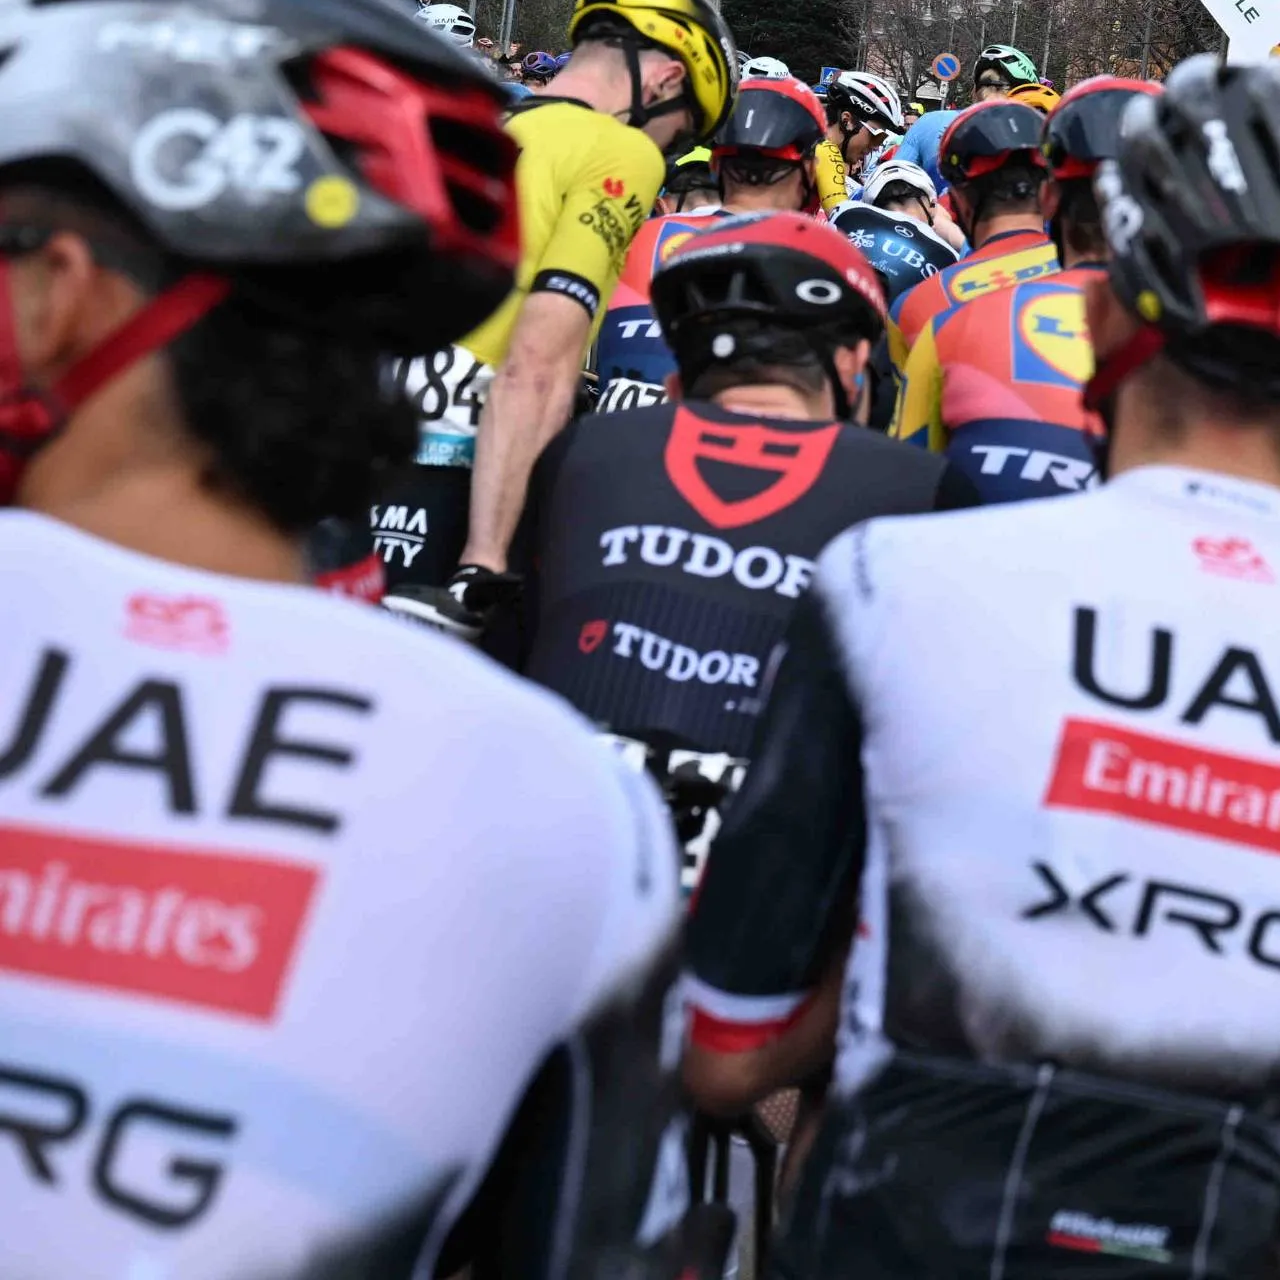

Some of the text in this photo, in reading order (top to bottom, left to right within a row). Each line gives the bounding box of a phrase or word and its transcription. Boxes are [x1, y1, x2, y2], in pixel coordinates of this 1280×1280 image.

[823, 144, 845, 185] Cofid
[881, 238, 941, 281] UBS
[613, 621, 760, 687] TUDOR
[0, 862, 261, 972] mirates
